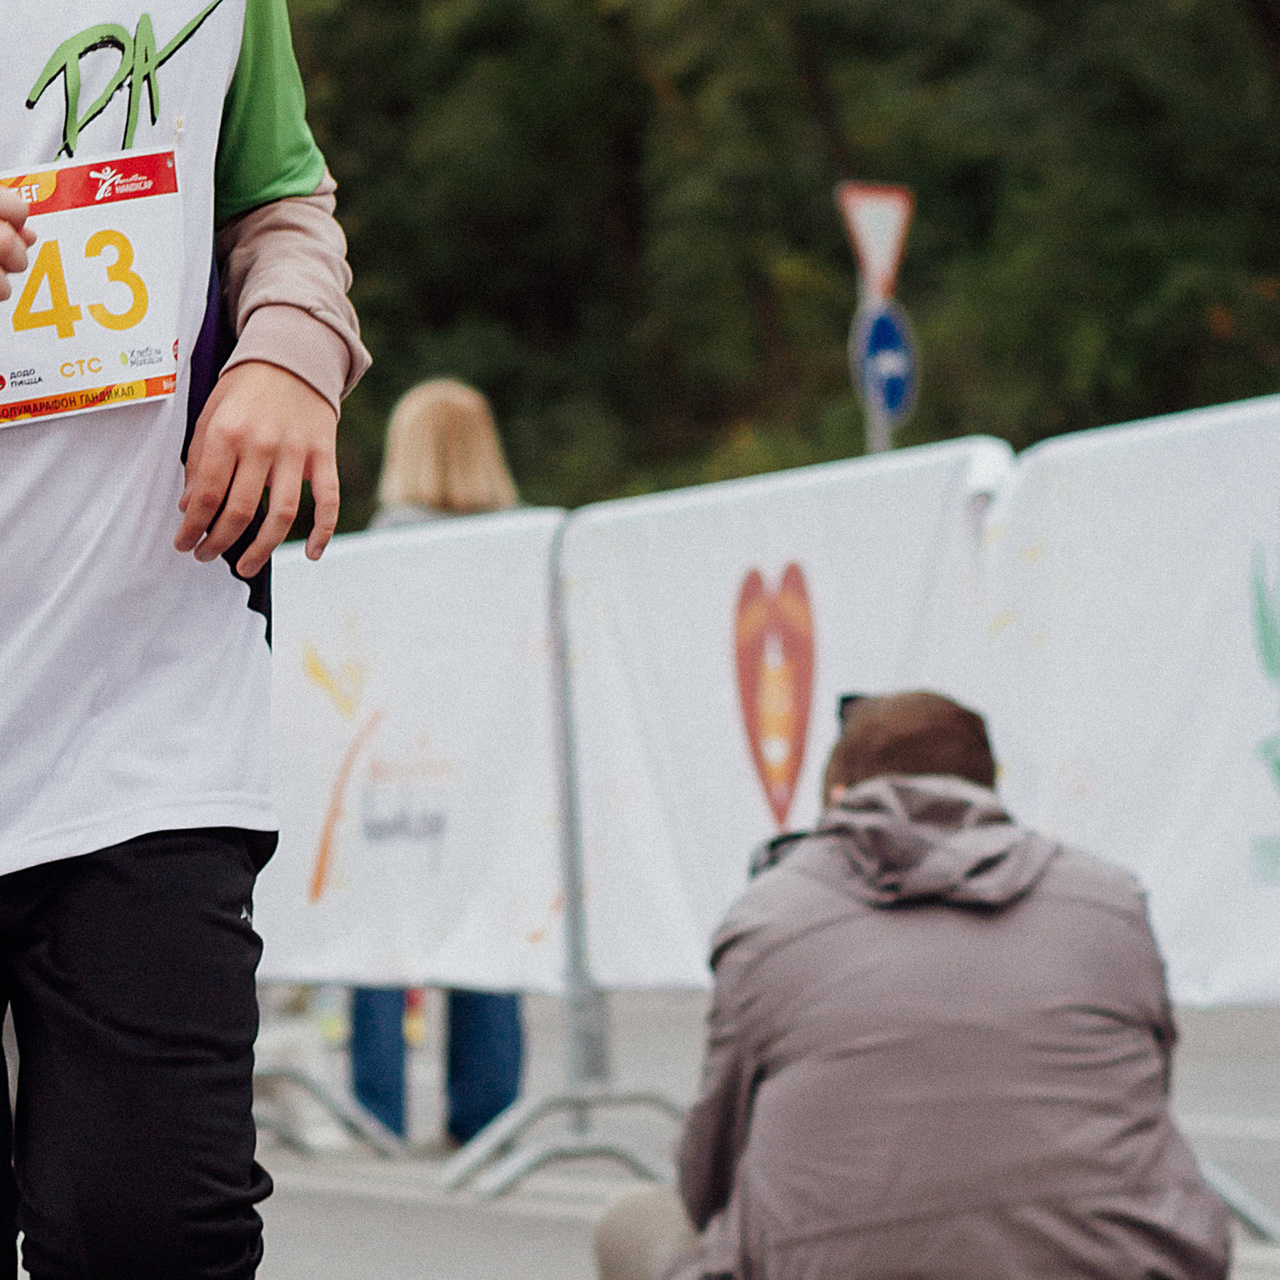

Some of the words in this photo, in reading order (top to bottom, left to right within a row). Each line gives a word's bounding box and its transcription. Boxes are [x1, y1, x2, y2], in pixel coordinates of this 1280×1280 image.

[9, 369, 36, 380] ДОДО
[60, 357, 102, 378] СТС
[10, 377, 43, 388] ПИЦЦА
[79, 385, 135, 406] ГАНДИКАП
